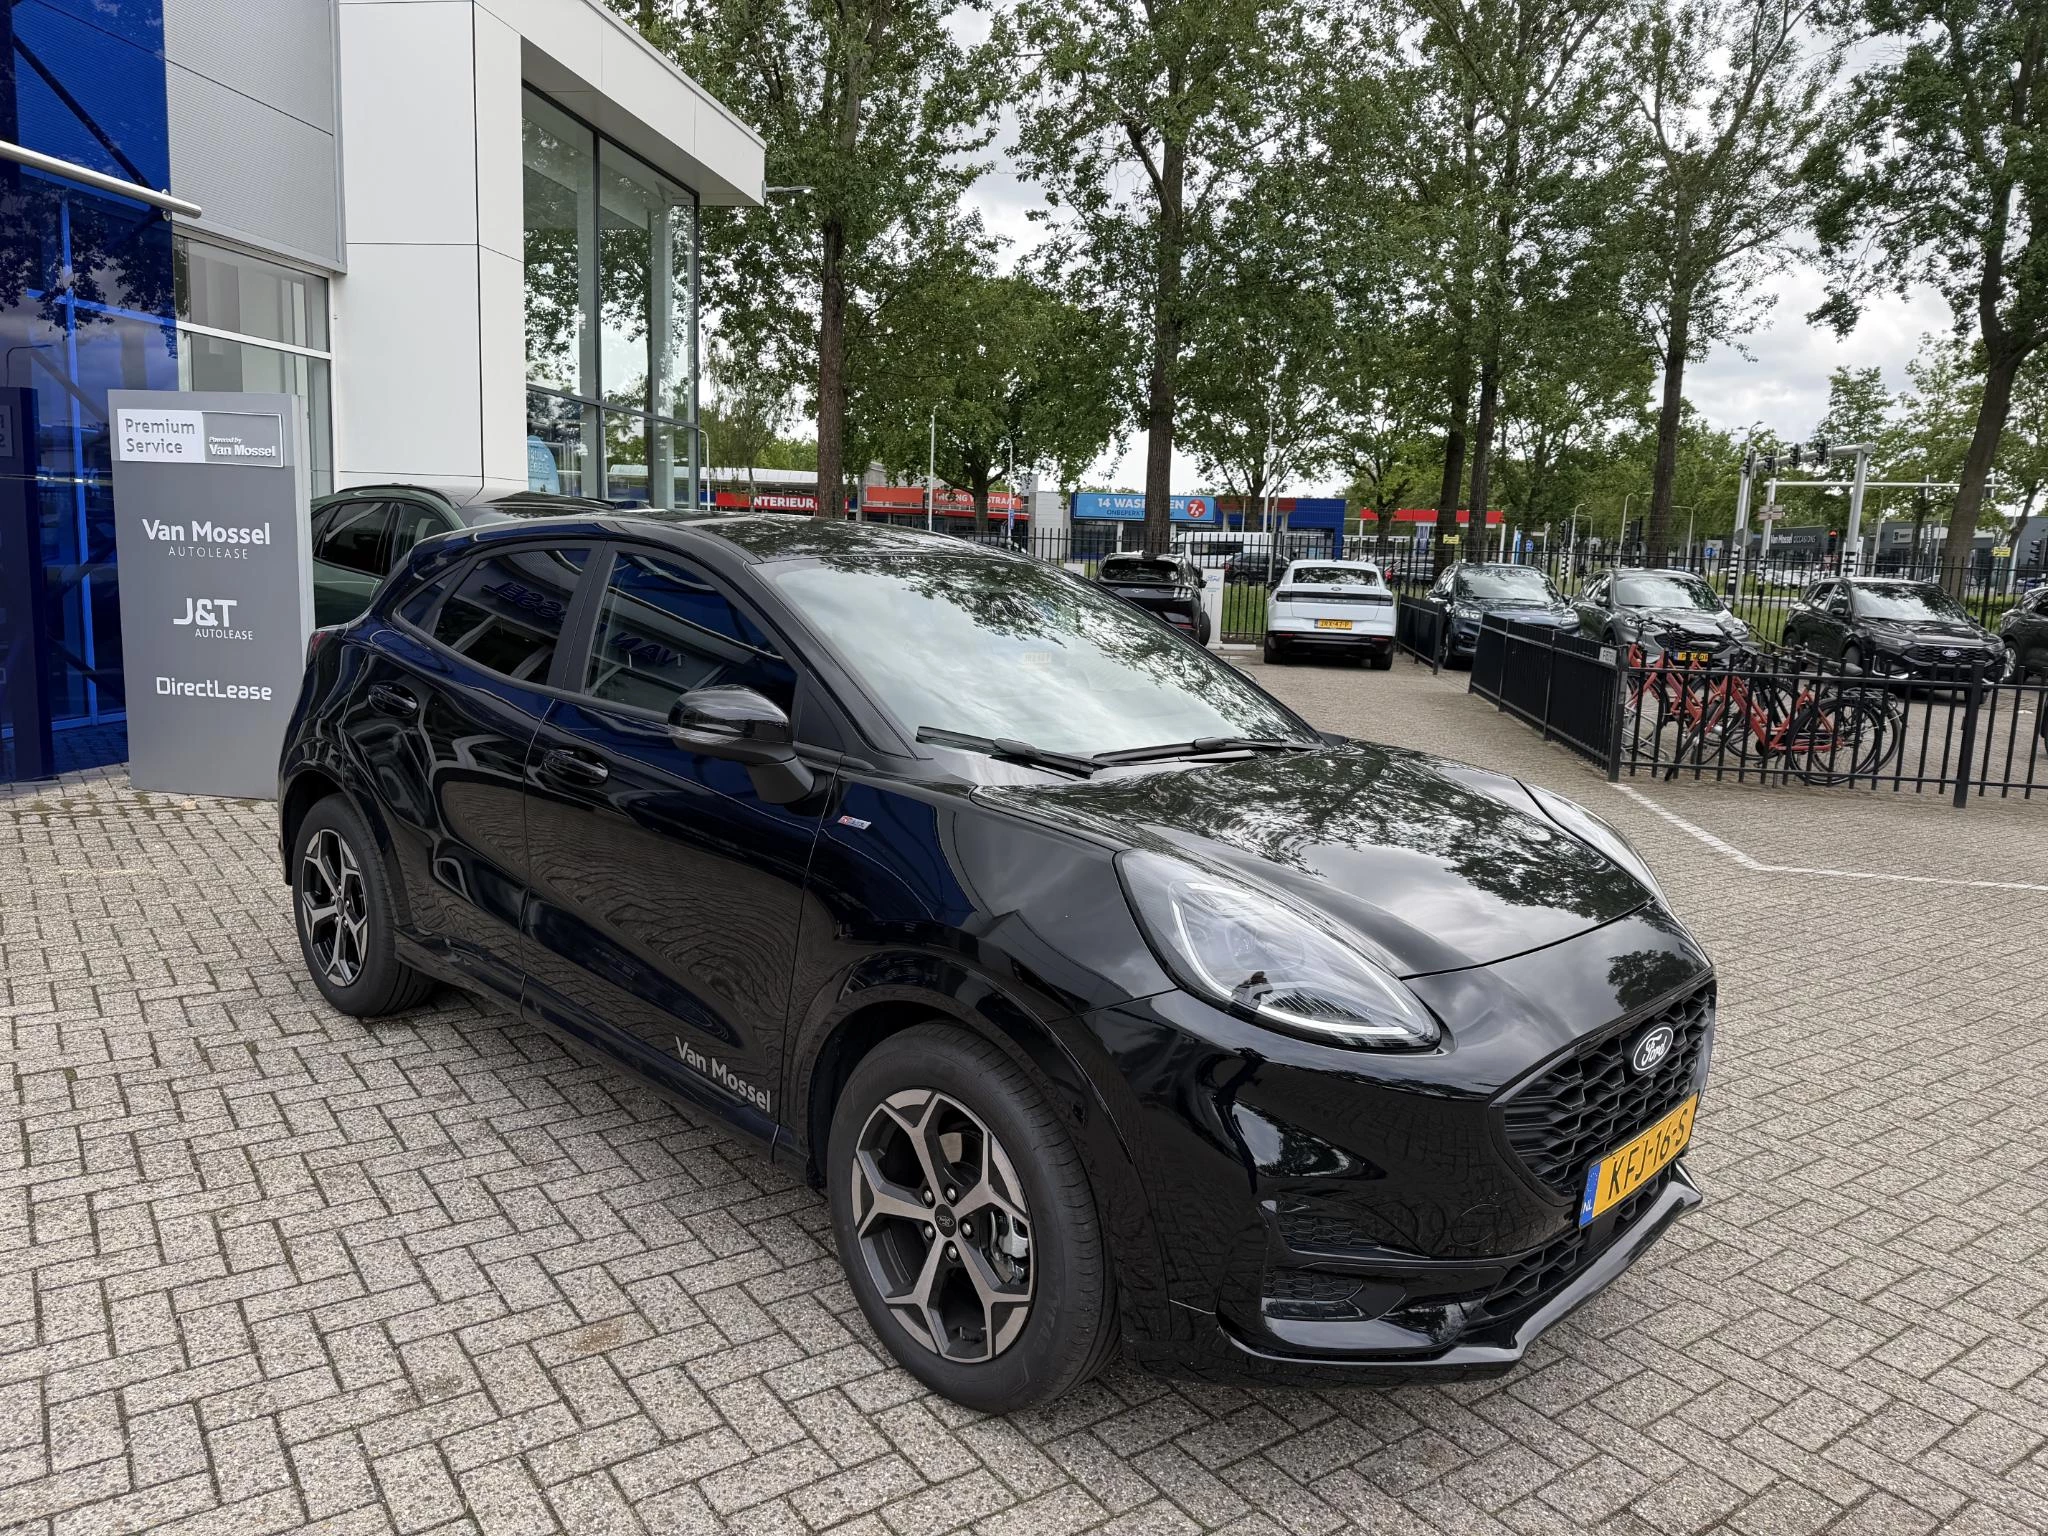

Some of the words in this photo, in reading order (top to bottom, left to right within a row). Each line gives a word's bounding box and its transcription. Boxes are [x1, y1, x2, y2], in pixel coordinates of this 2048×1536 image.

[125, 418, 195, 434] Premium
[126, 438, 183, 454] Service
[208, 436, 233, 444] Powered
[208, 445, 232, 455] Van
[234, 445, 276, 457] Mossel
[1097, 498, 1111, 508] 14
[142, 519, 184, 541] Van
[191, 521, 271, 545] Mossel
[168, 546, 249, 560] AUTOLEASE
[173, 597, 238, 628] J&T
[195, 628, 254, 640] AUTOLEASE
[156, 676, 272, 701] DirectLease
[1640, 1032, 1669, 1067] Ford
[675, 1036, 707, 1073] Van
[711, 1057, 771, 1113] Mossel
[1608, 1108, 1688, 1201] KFJ-16-S
[1581, 1198, 1593, 1215] NL
